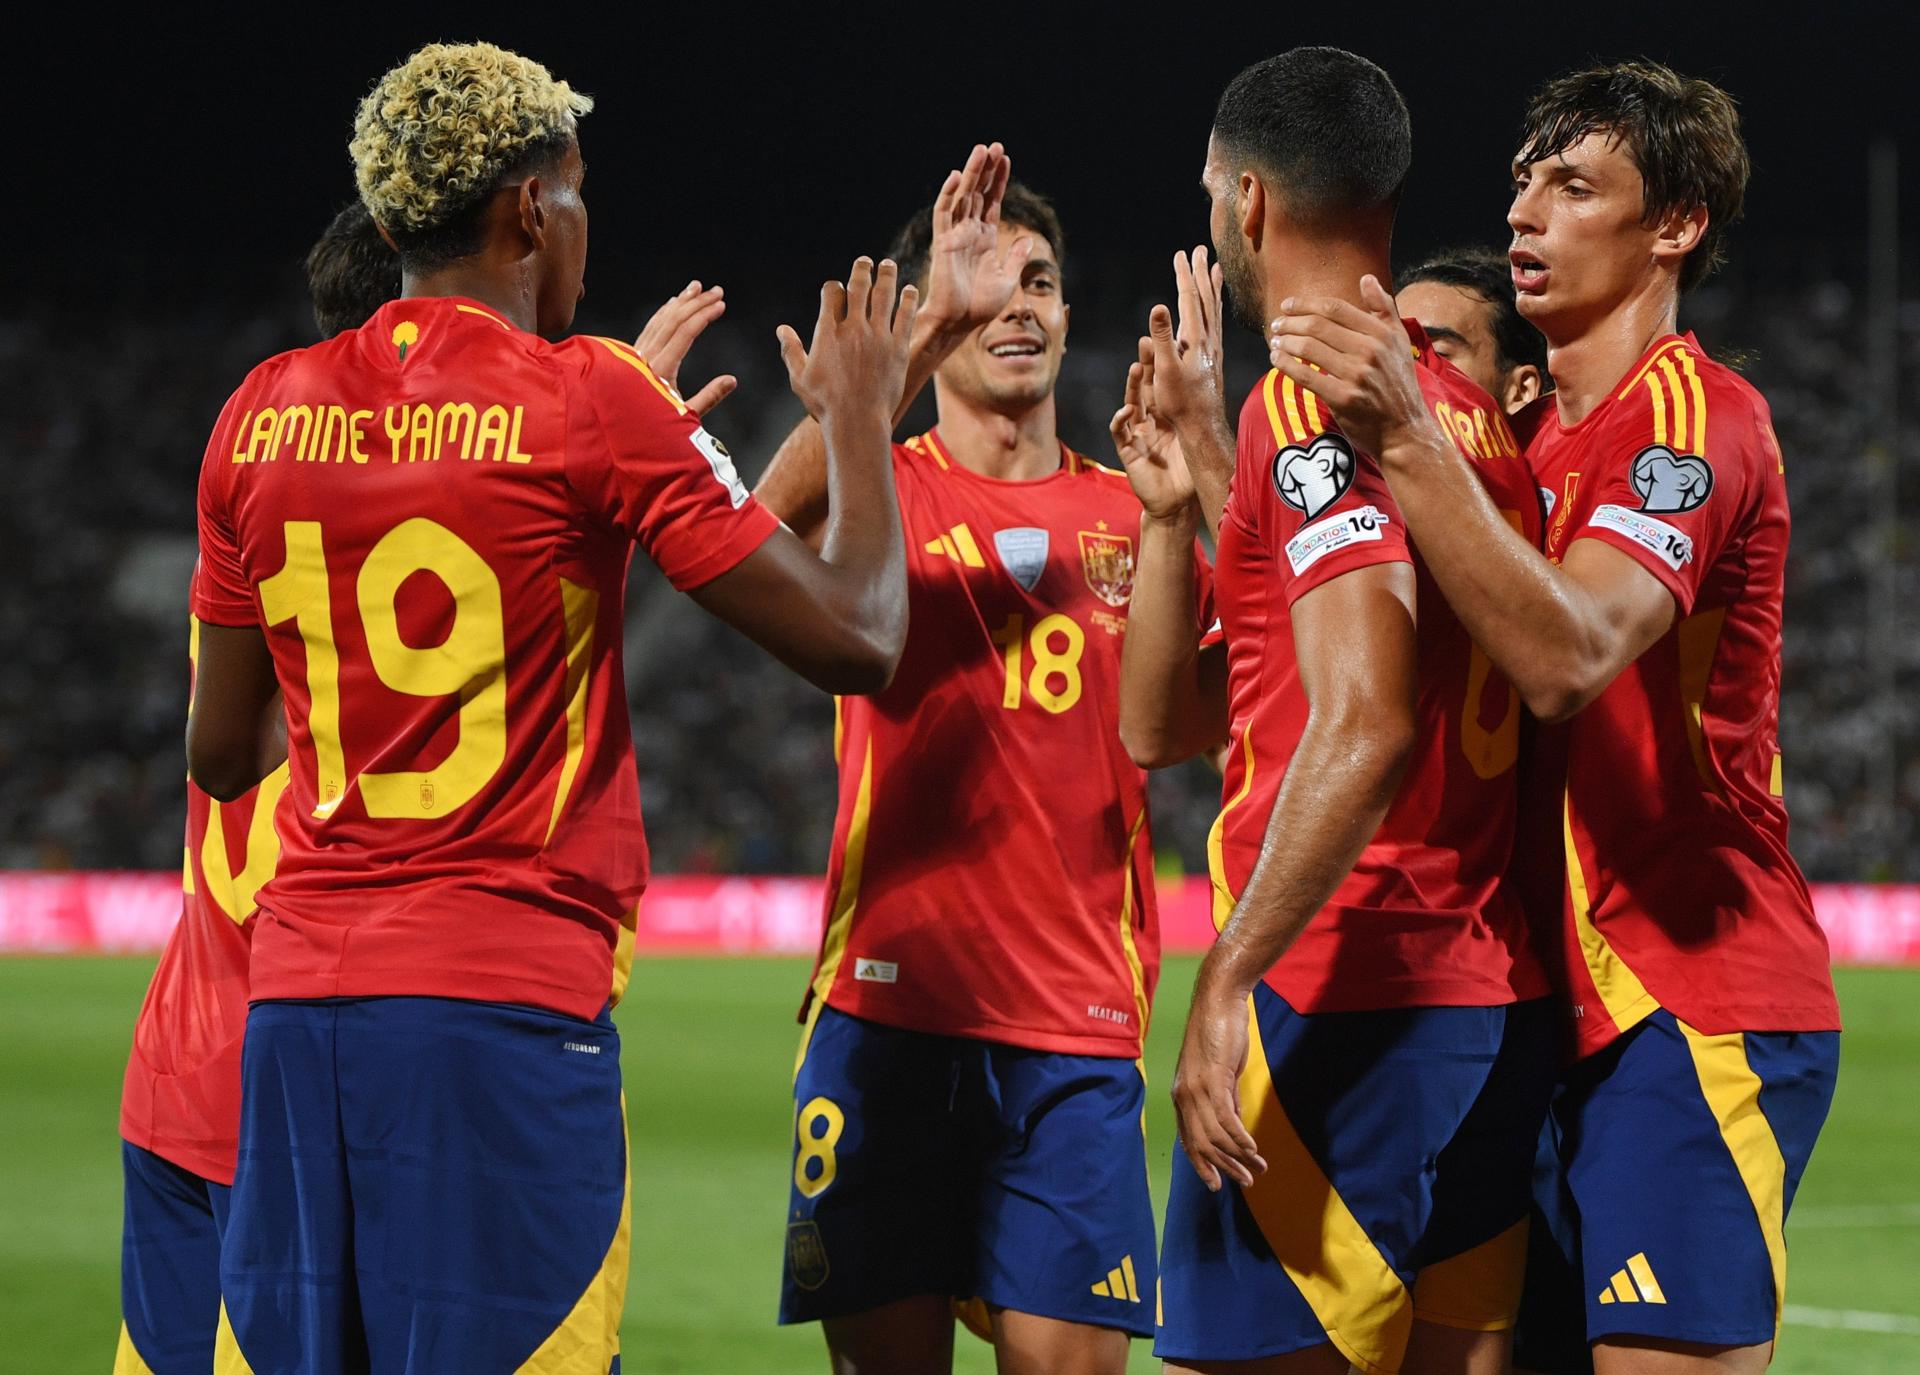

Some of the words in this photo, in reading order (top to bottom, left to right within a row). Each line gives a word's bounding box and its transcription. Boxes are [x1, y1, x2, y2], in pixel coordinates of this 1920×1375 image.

[232, 403, 372, 464] LAMINE
[385, 403, 532, 464] YAMAL
[1292, 525, 1349, 564] FOUNDATION
[1348, 514, 1376, 533] 10
[1596, 511, 1664, 542] FOUNDATION
[258, 517, 507, 820] 19
[991, 613, 1086, 714] 18
